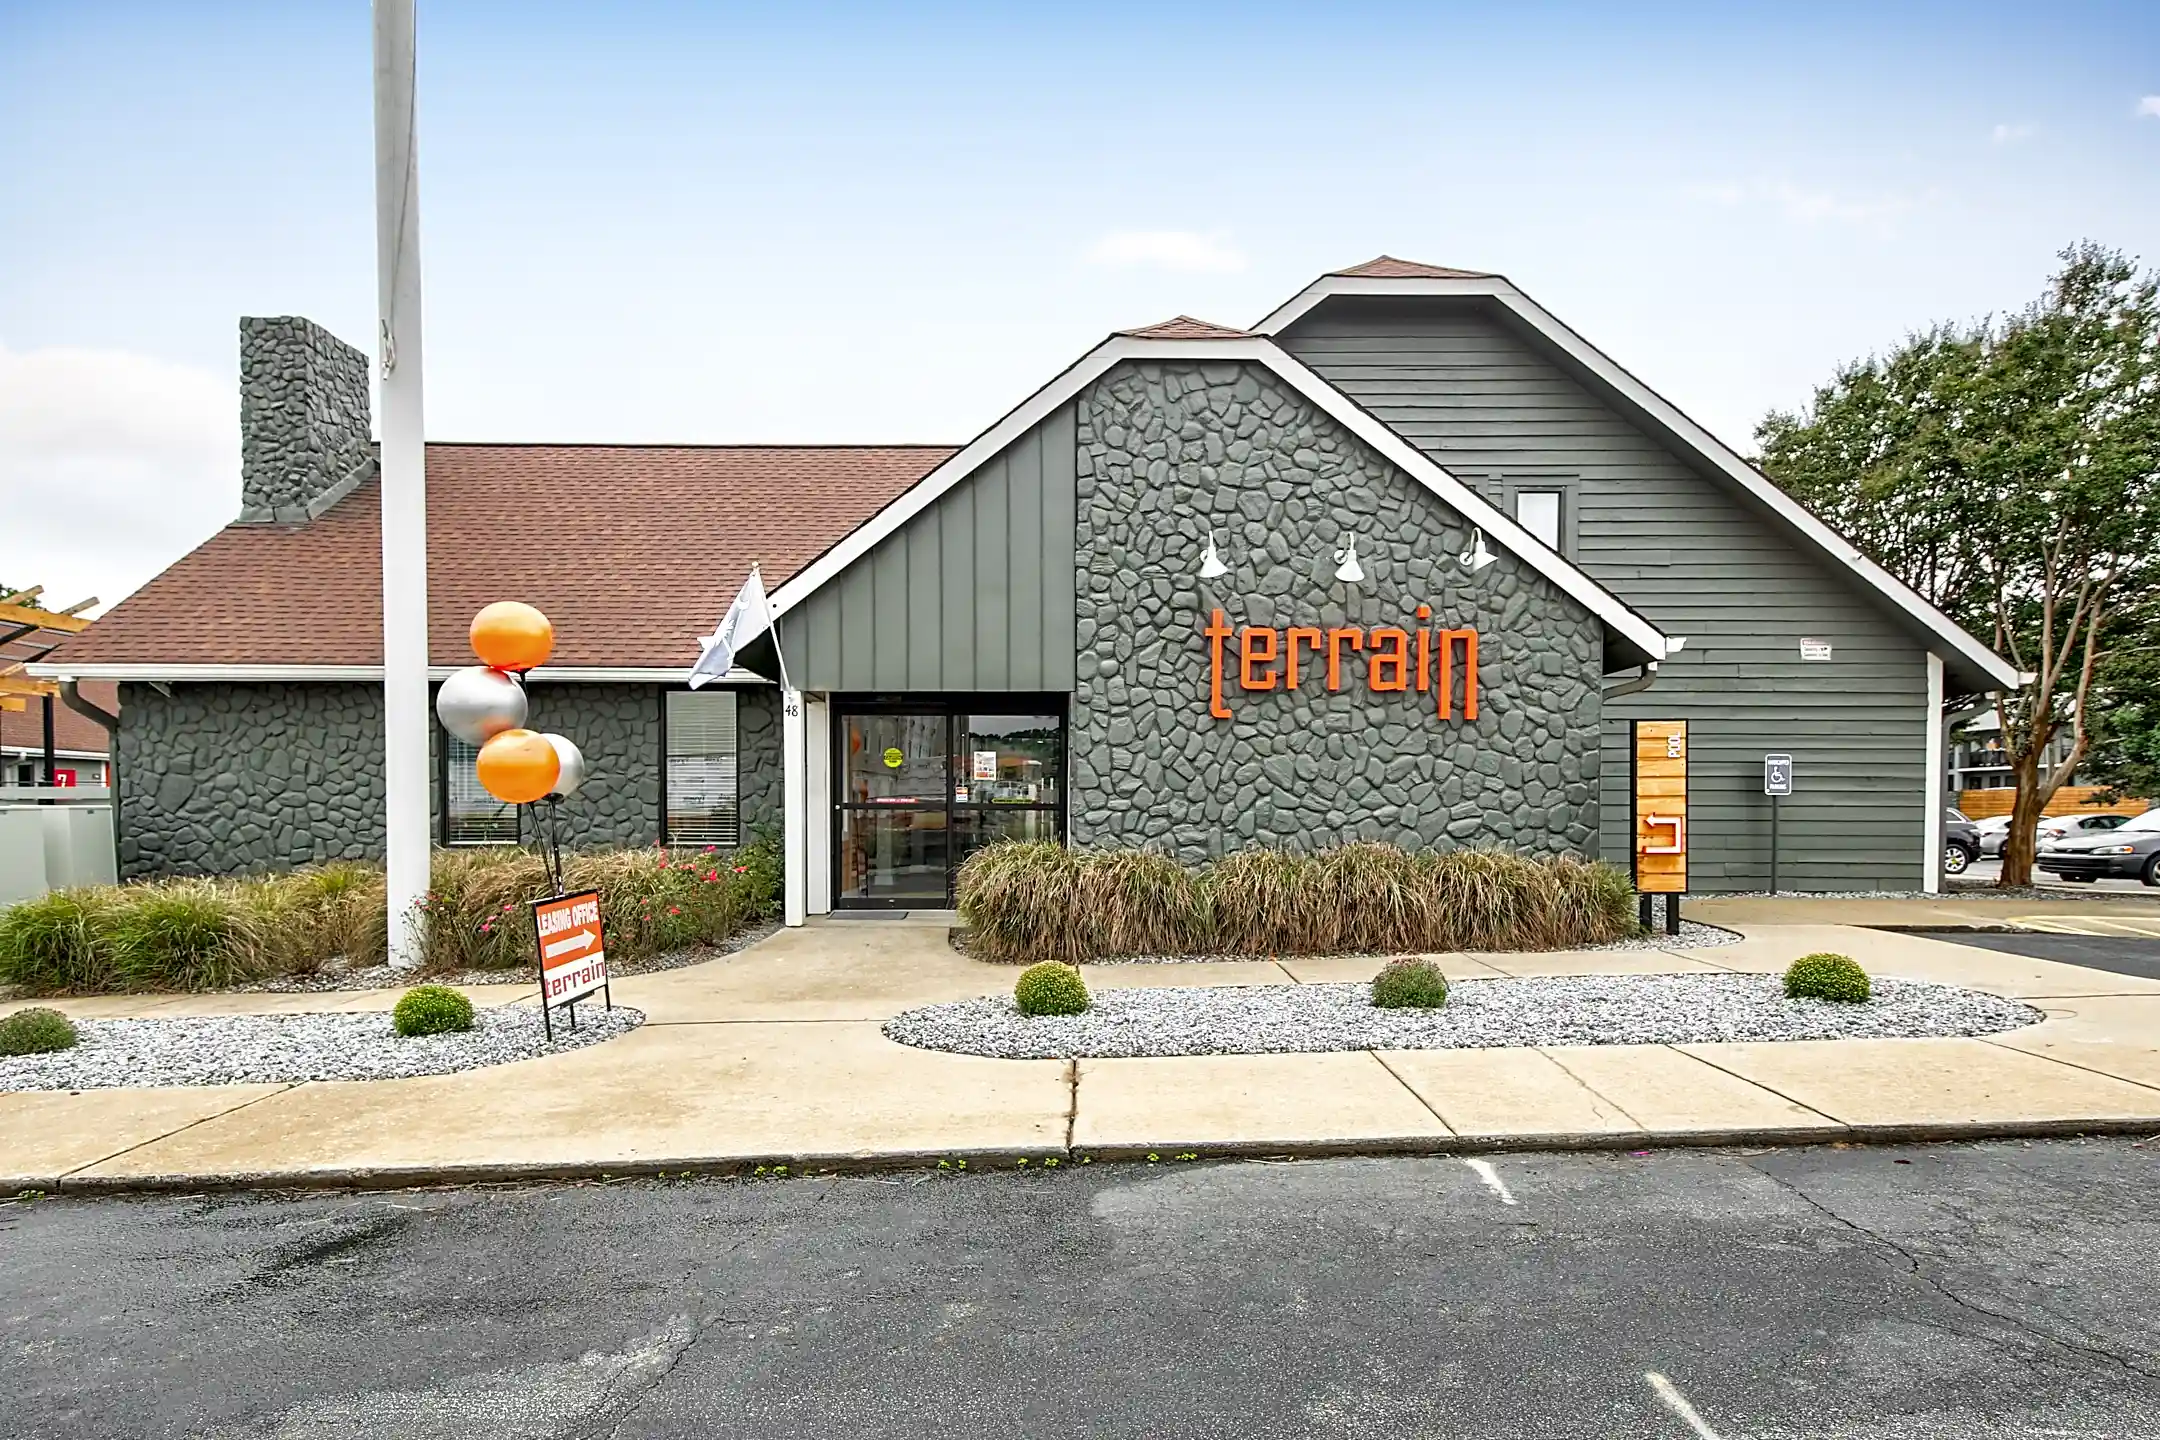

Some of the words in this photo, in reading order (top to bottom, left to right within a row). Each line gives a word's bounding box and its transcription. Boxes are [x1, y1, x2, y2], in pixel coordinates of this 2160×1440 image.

[1205, 604, 1478, 720] terrain
[785, 704, 799, 717] 48
[1667, 731, 1681, 758] POOL
[537, 907, 572, 936] LEASING
[572, 901, 599, 927] OFFICE
[544, 959, 606, 1000] terrain
